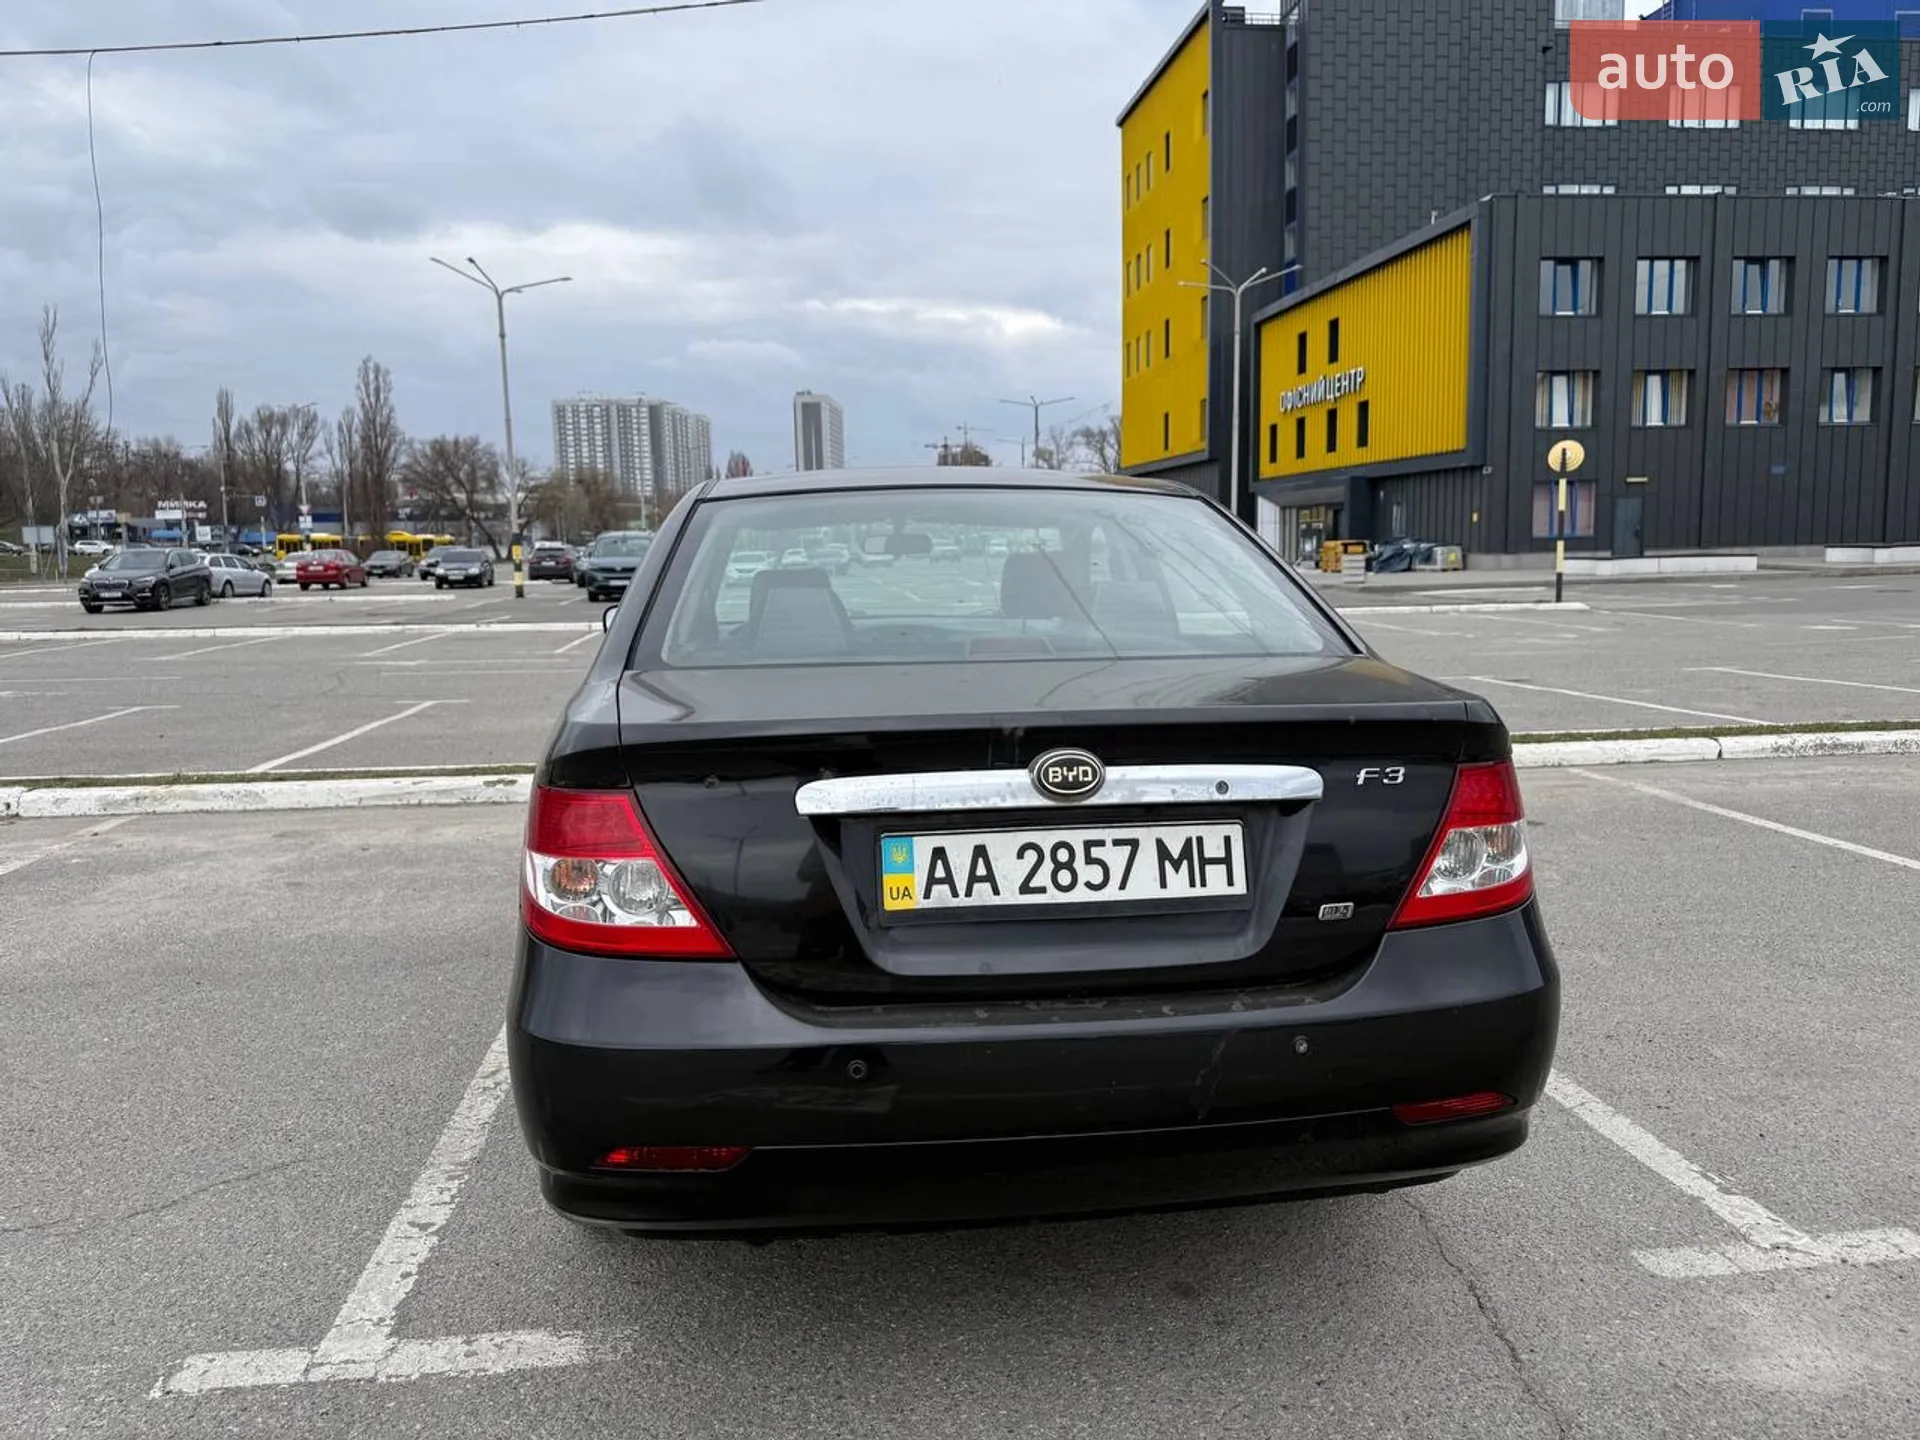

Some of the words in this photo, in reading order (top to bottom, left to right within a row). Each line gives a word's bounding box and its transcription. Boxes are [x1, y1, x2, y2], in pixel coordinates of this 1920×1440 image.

[1048, 766, 1092, 783] BYD
[1356, 766, 1405, 785] F3
[922, 845, 1001, 900] AA
[1016, 837, 1140, 895] 2857
[1154, 834, 1235, 889] MH
[889, 885, 913, 901] UA
